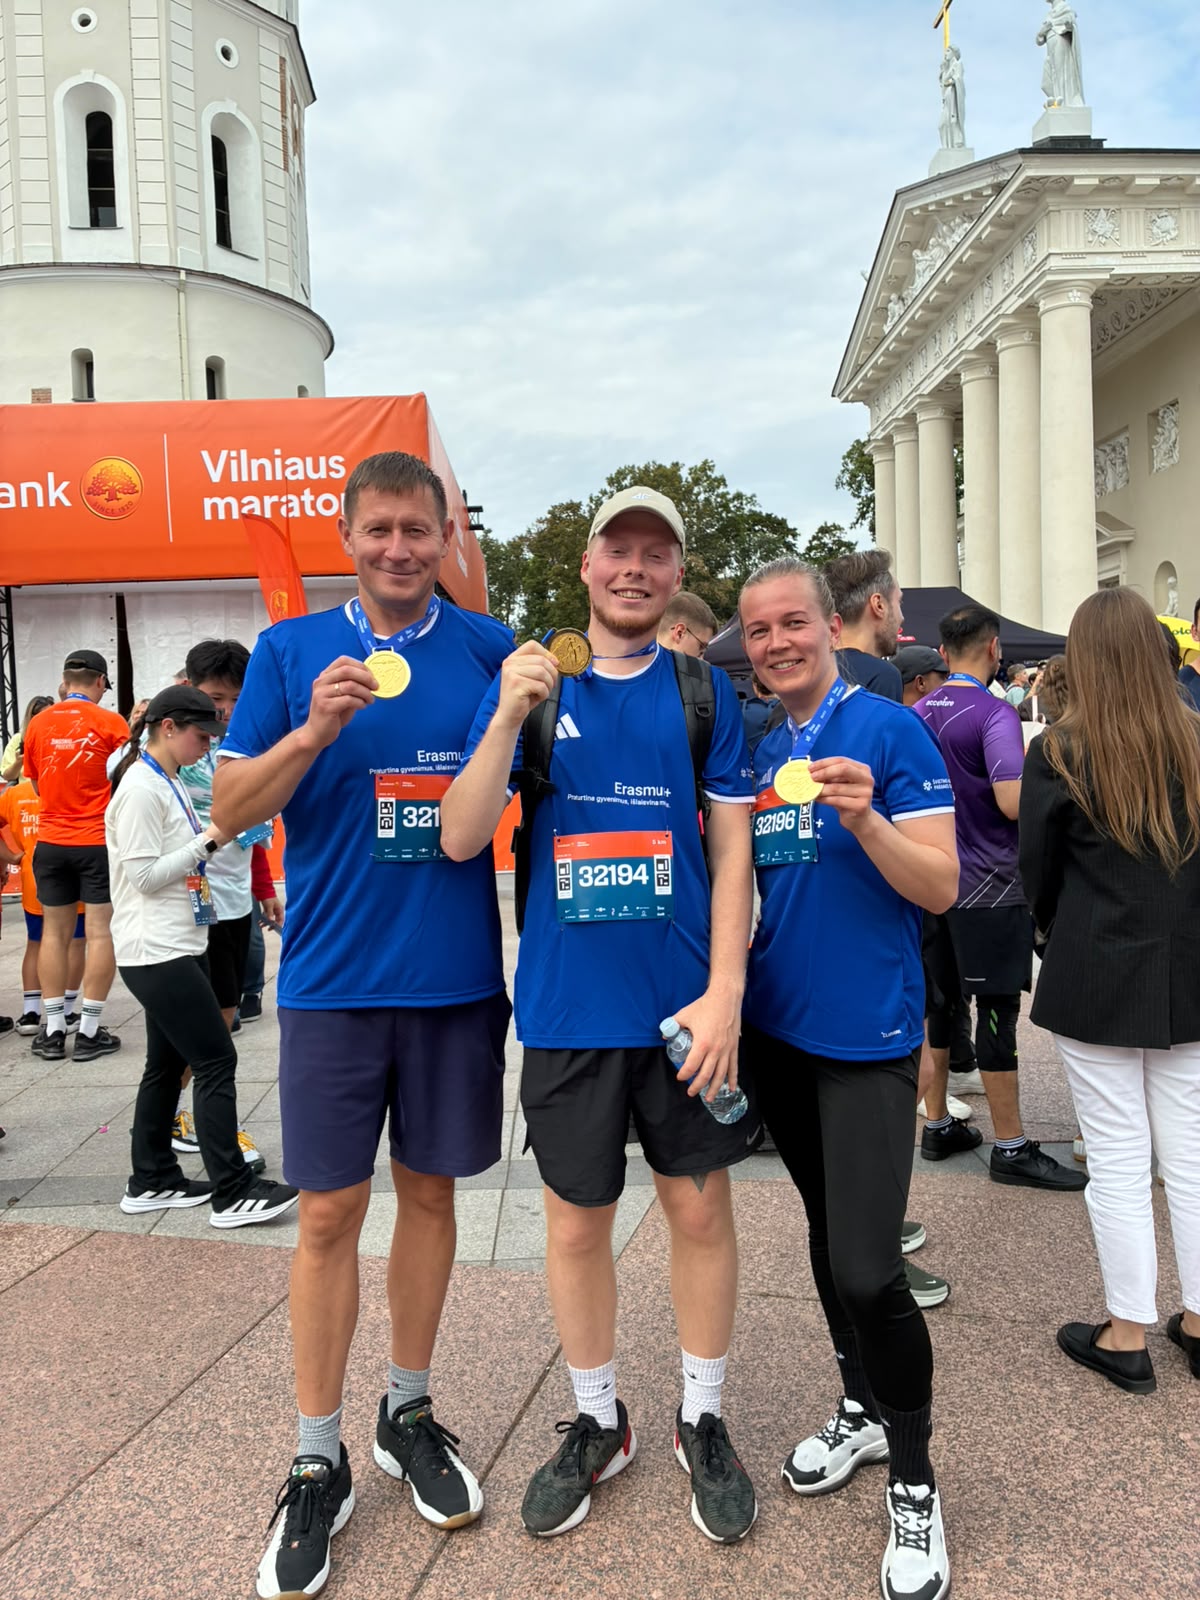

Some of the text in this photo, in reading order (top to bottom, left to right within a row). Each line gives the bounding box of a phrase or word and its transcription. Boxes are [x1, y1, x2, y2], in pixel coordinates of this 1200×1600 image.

[200, 448, 346, 483] Vilniaus
[0, 471, 72, 509] ank
[92, 501, 115, 514] SINCE
[614, 781, 671, 797] Erasmu+
[402, 806, 440, 828] 321
[755, 809, 796, 836] 32196
[578, 863, 649, 887] 32194
